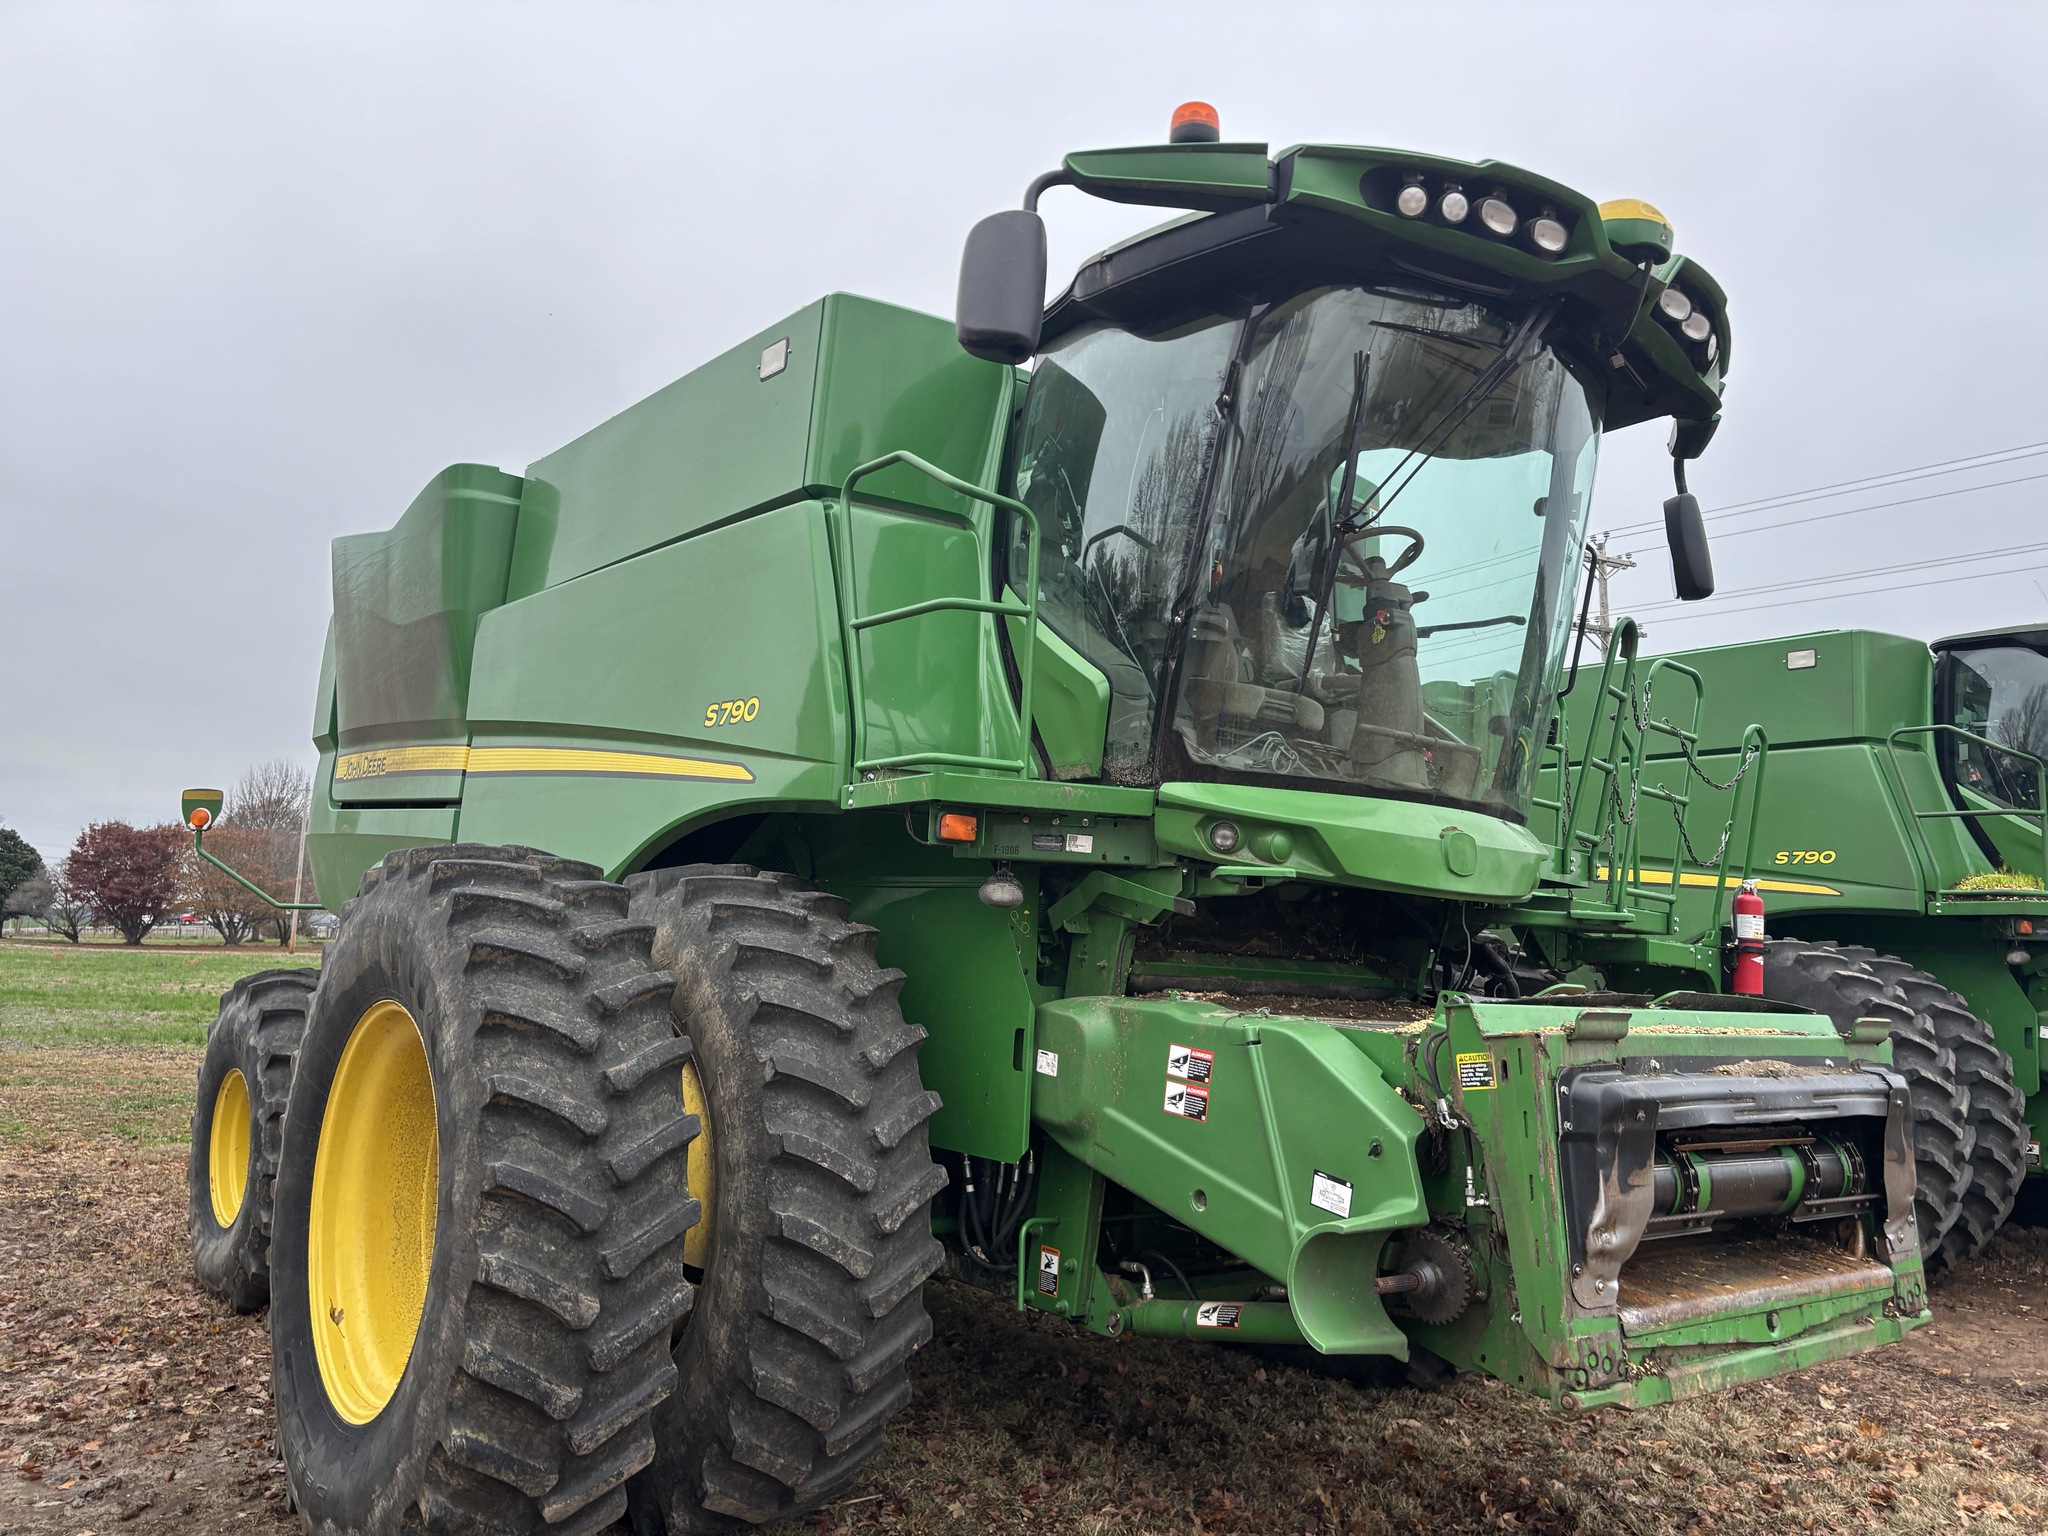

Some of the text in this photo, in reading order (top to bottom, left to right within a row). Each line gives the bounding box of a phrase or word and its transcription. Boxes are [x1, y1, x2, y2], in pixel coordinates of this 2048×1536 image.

[704, 696, 760, 728] S790
[343, 756, 387, 778] JOHN DEERE
[1774, 850, 1837, 865] S790
[1195, 1051, 1212, 1059] DANGER
[1463, 1053, 1492, 1062] CAUTION
[1190, 1087, 1208, 1096] DANGER
